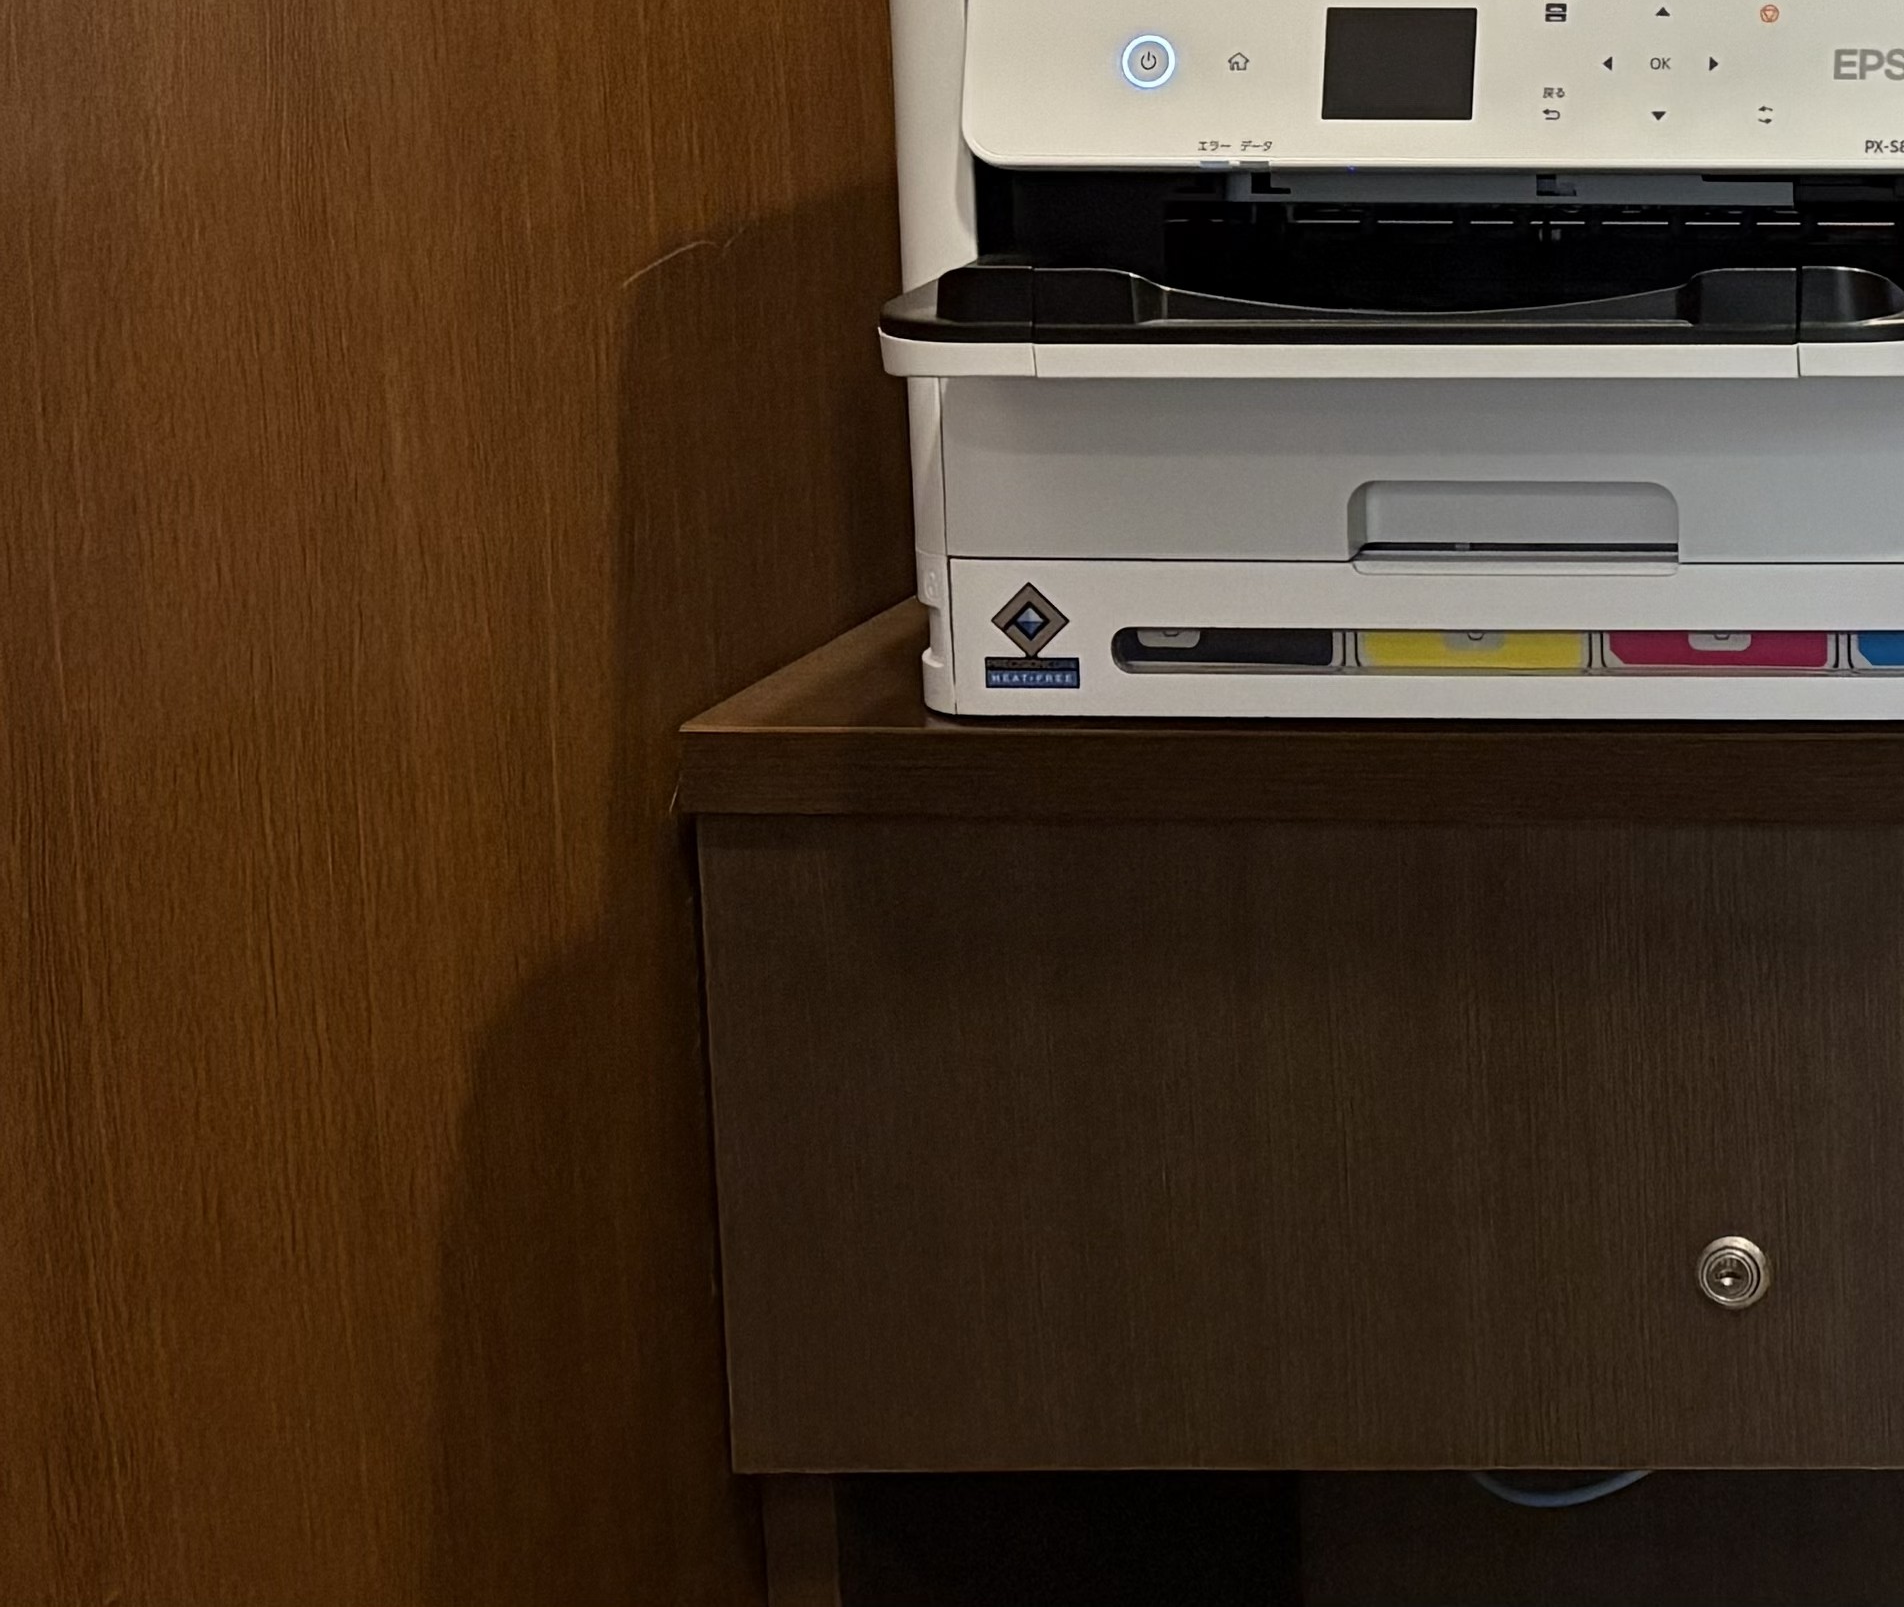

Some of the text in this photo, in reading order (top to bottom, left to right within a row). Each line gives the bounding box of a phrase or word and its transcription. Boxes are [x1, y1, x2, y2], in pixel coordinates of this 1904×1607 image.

[1649, 57, 1672, 71] OK
[1543, 87, 1566, 99] 戻る
[1198, 141, 1273, 152] エラー データ
